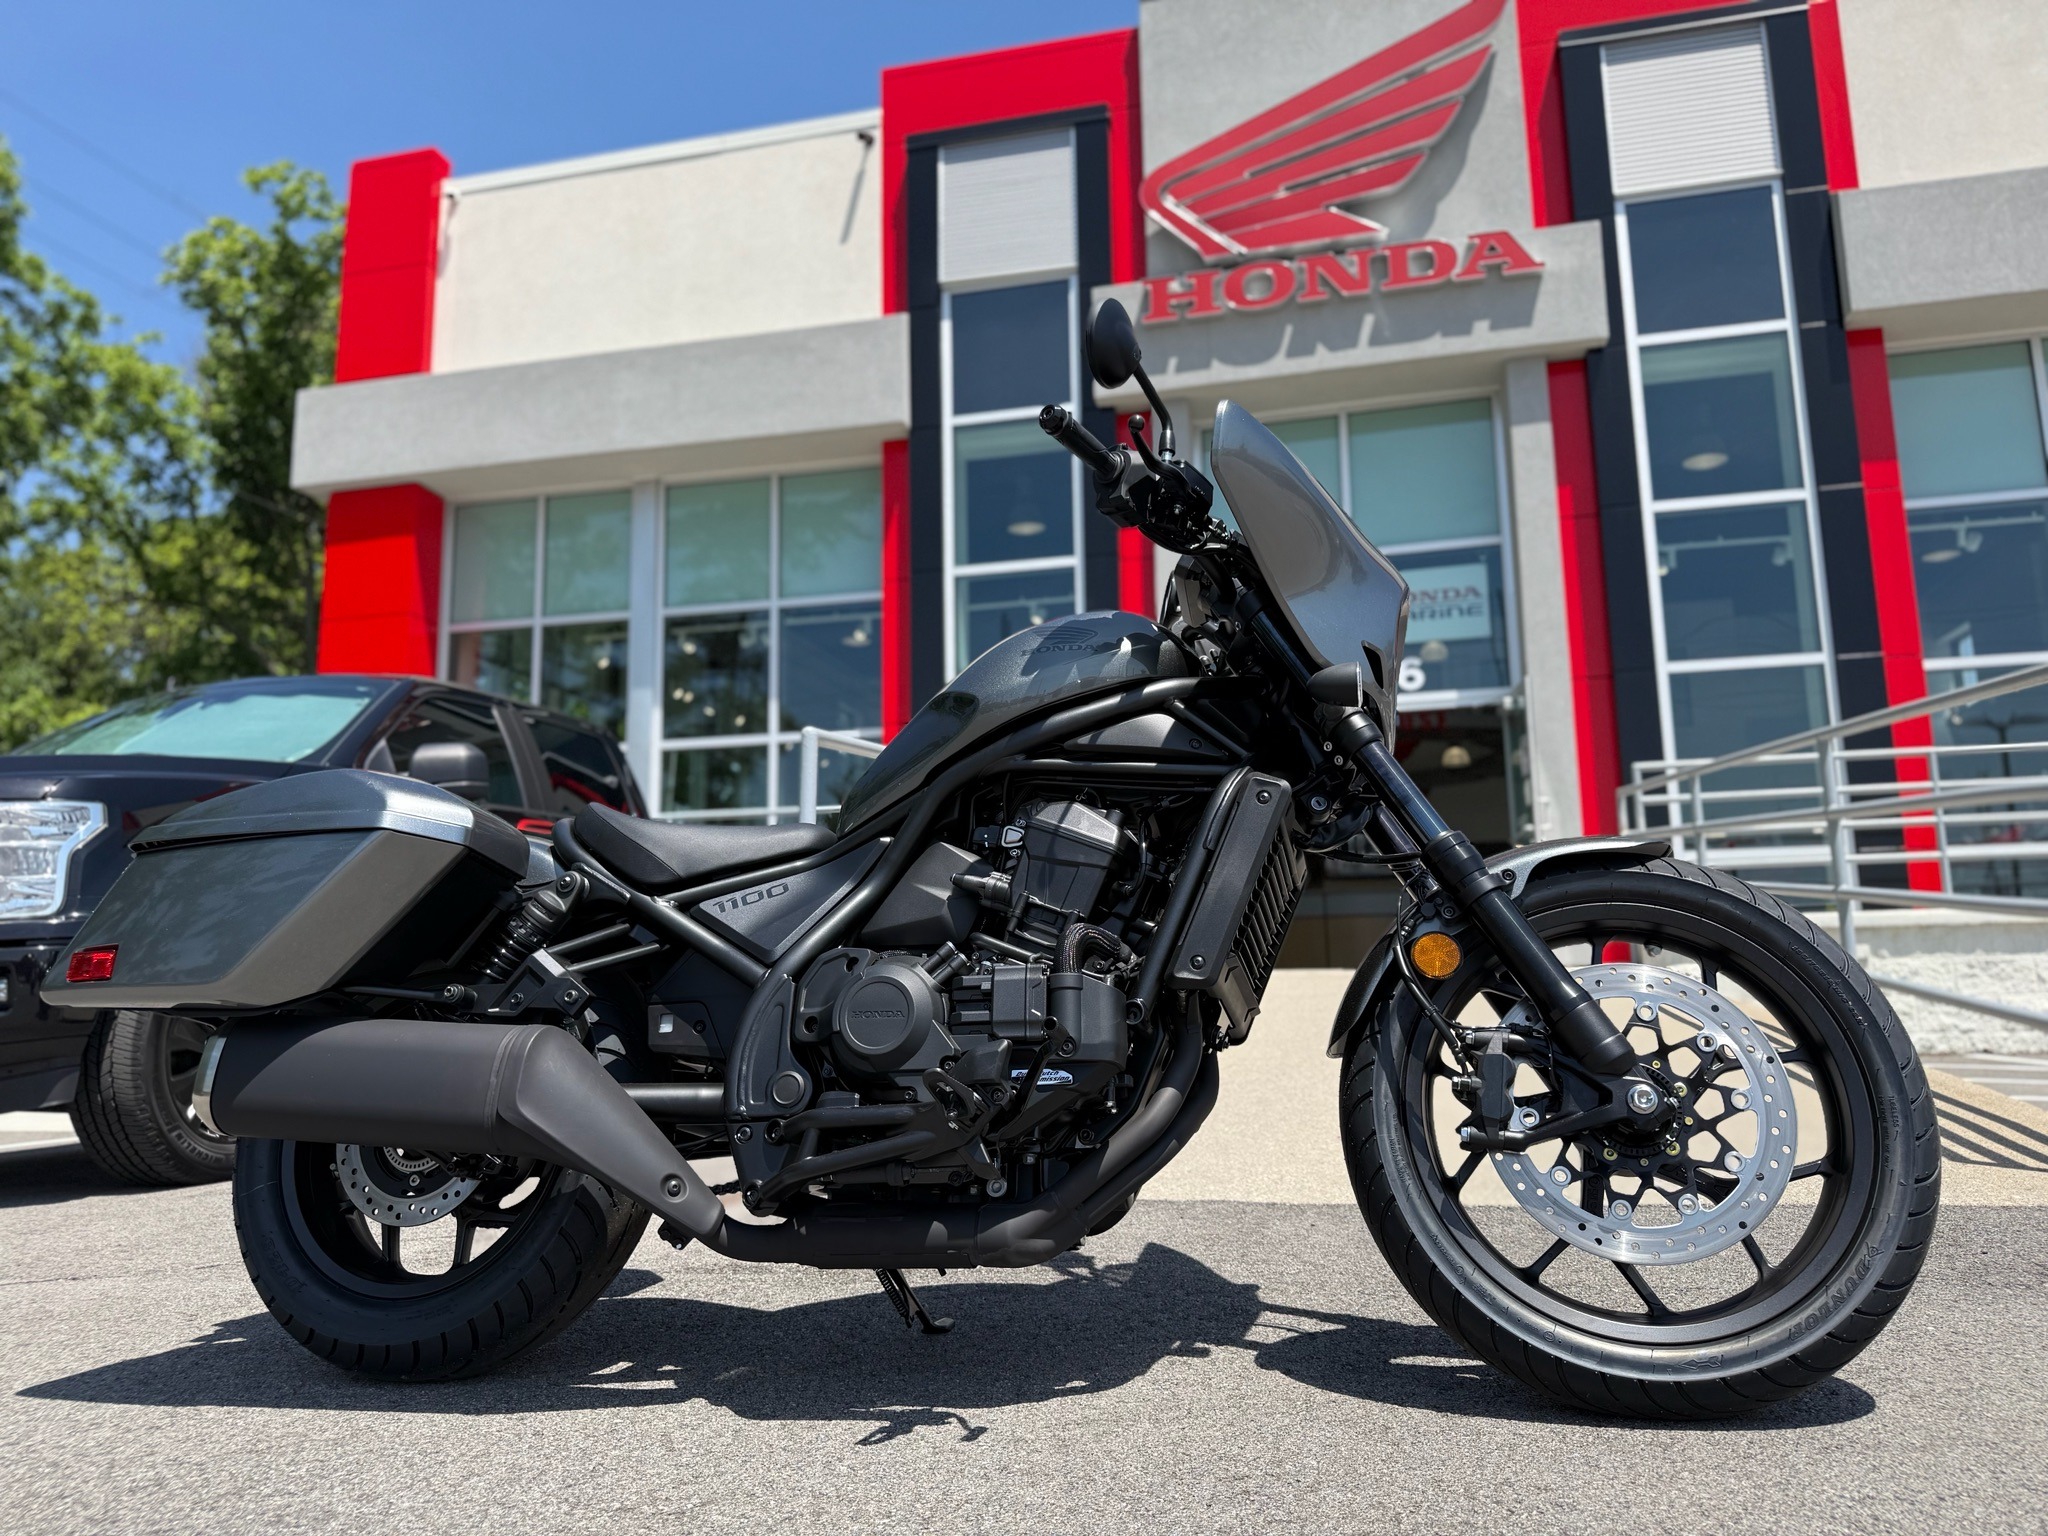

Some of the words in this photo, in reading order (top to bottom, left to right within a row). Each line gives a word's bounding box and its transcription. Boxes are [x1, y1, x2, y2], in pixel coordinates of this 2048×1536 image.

[1141, 230, 1545, 324] HONDA
[1020, 644, 1098, 658] HONDA
[712, 882, 790, 913] 1100
[851, 1010, 905, 1019] HONDA
[1788, 1258, 1871, 1341] DUNLOP
